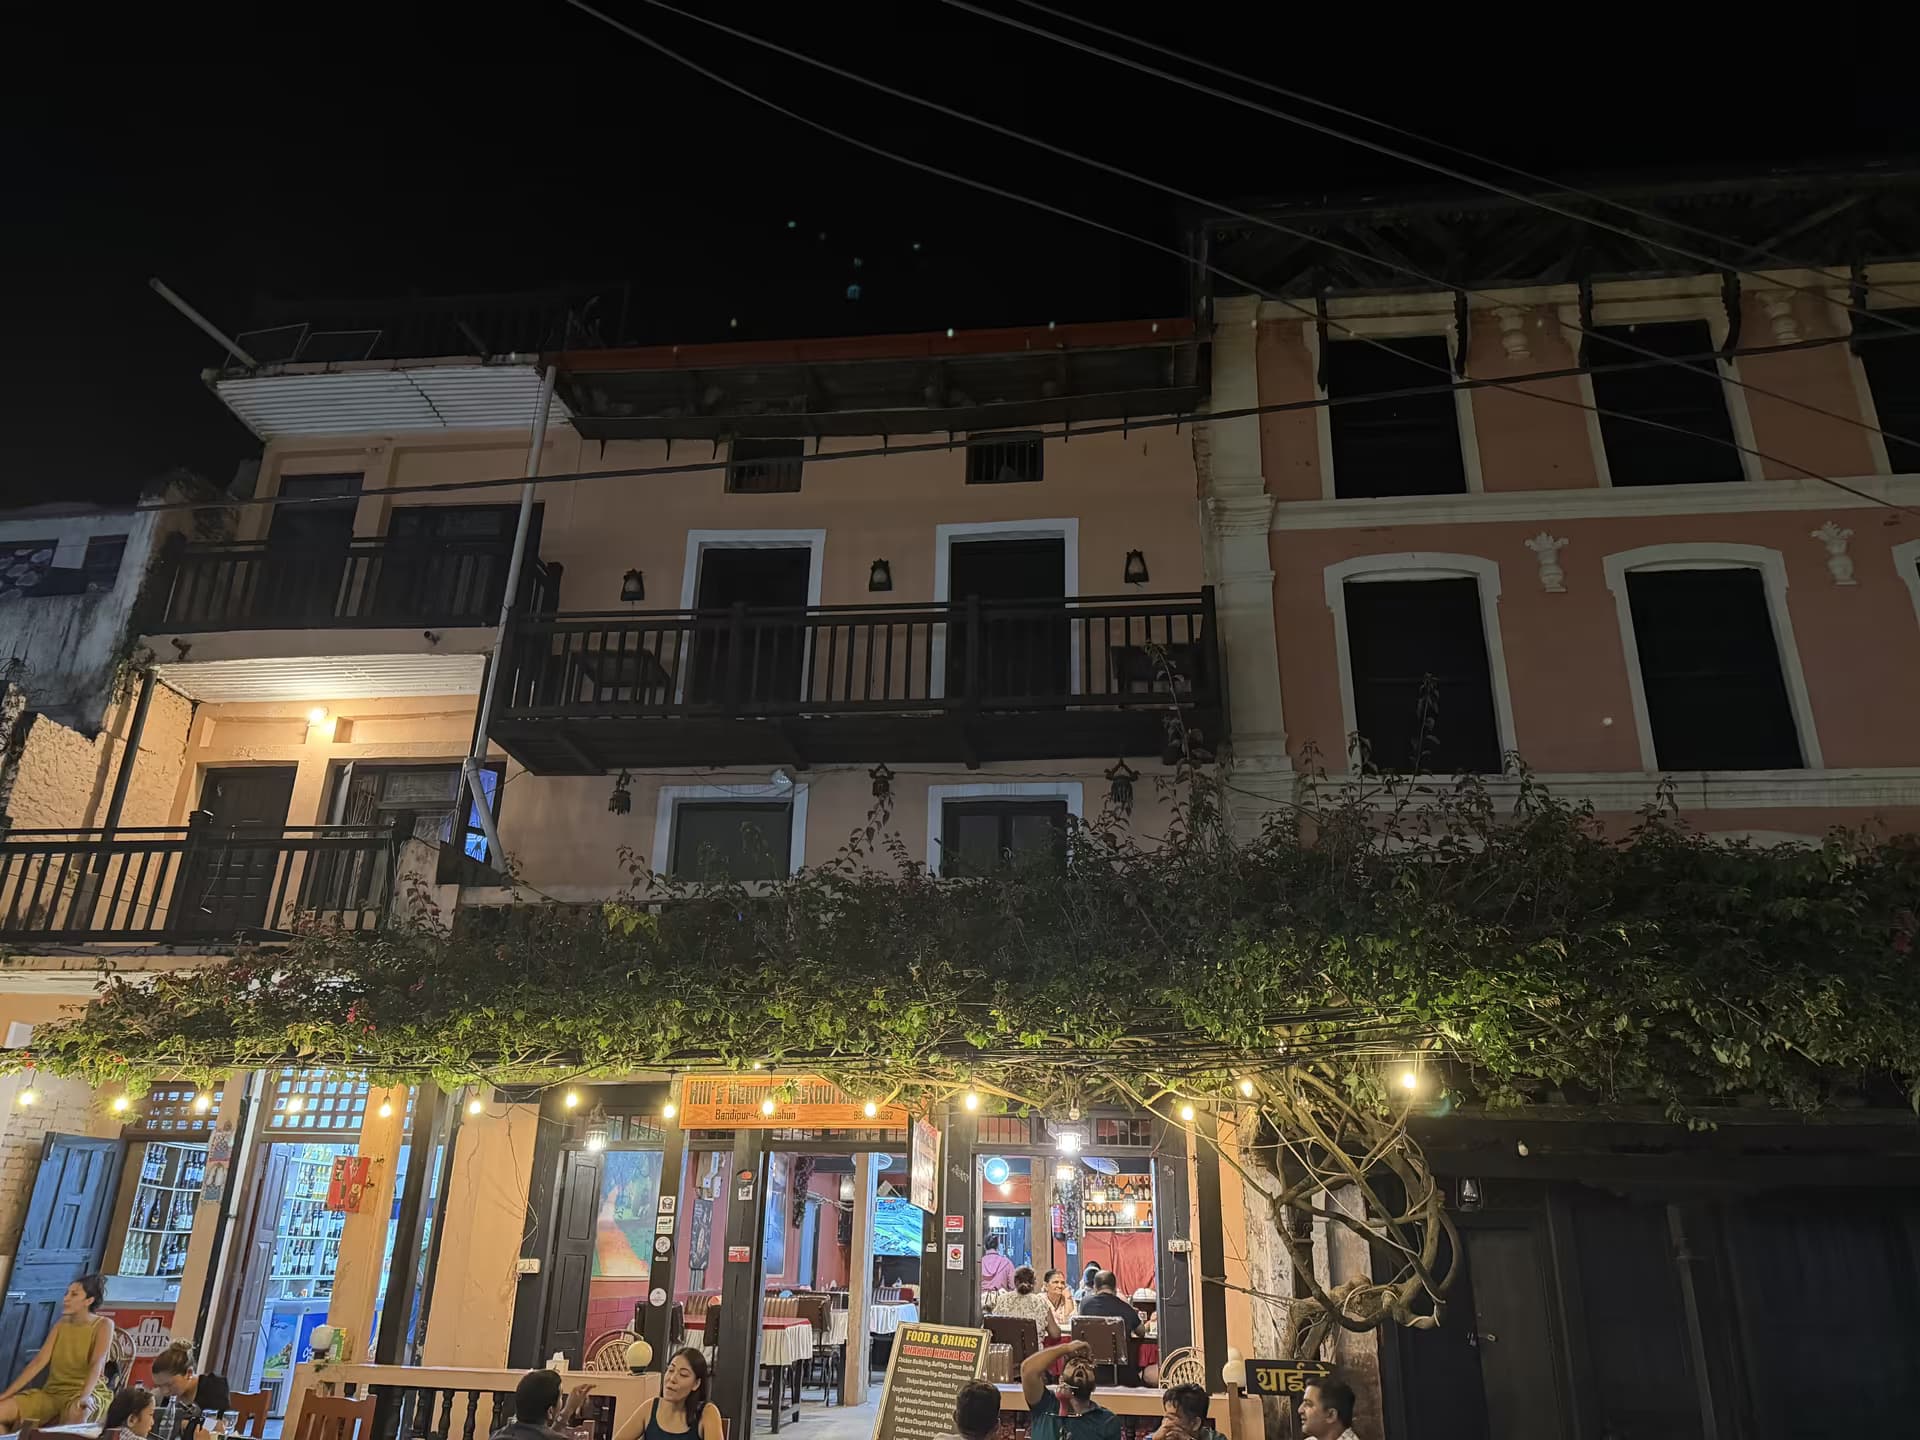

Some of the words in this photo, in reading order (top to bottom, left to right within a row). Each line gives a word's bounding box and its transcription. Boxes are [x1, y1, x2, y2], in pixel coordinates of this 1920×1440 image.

[906, 1330, 931, 1343] FOOD
[931, 1334, 939, 1344] &
[940, 1334, 978, 1348] DRINKS
